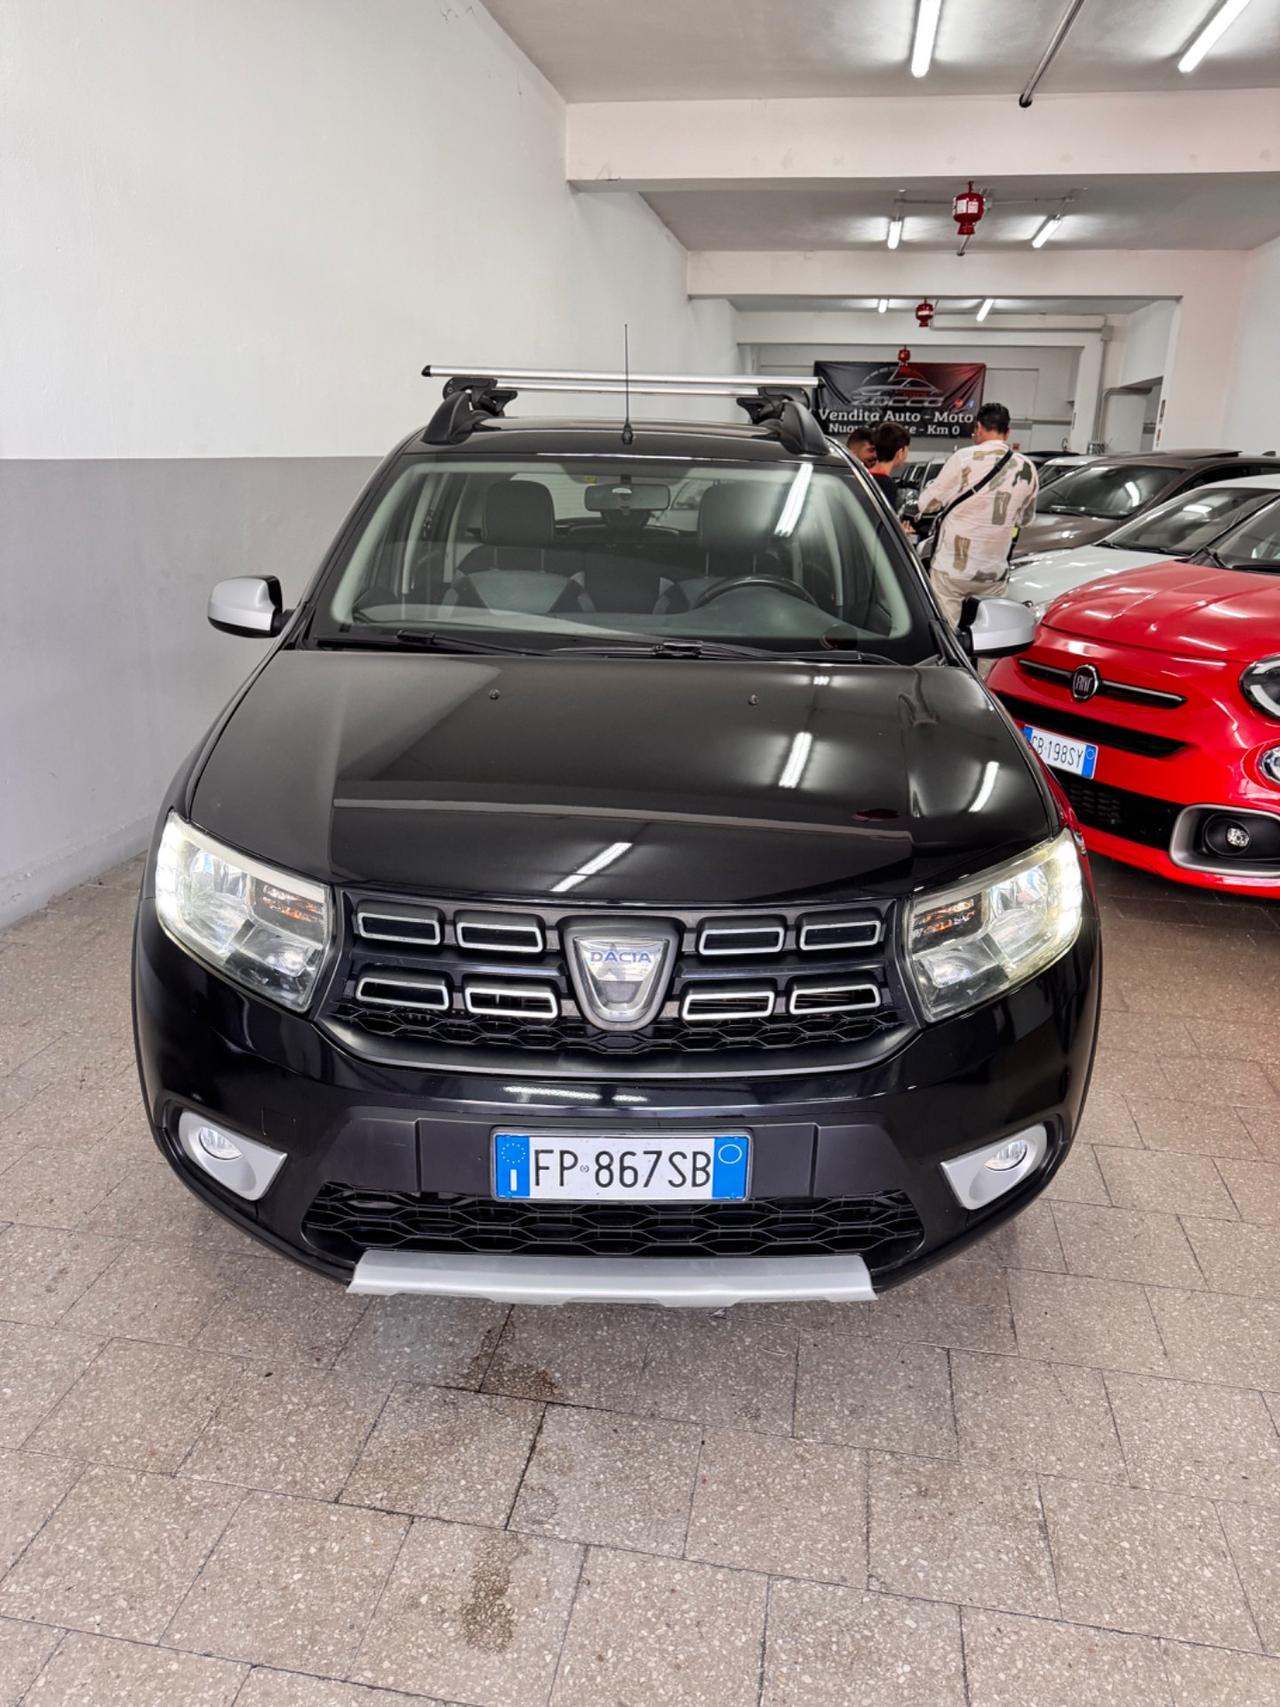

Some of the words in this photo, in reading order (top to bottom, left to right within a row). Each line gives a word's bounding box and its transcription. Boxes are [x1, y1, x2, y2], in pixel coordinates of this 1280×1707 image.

[818, 408, 880, 422] Vendita
[883, 410, 921, 422] Auto
[933, 411, 974, 423] Moto
[927, 424, 949, 435] Km
[952, 425, 960, 435] 0
[1047, 740, 1084, 768] 198SY
[590, 951, 651, 963] DACIA
[534, 1149, 578, 1187] FP
[594, 1150, 712, 1188] 867SB
